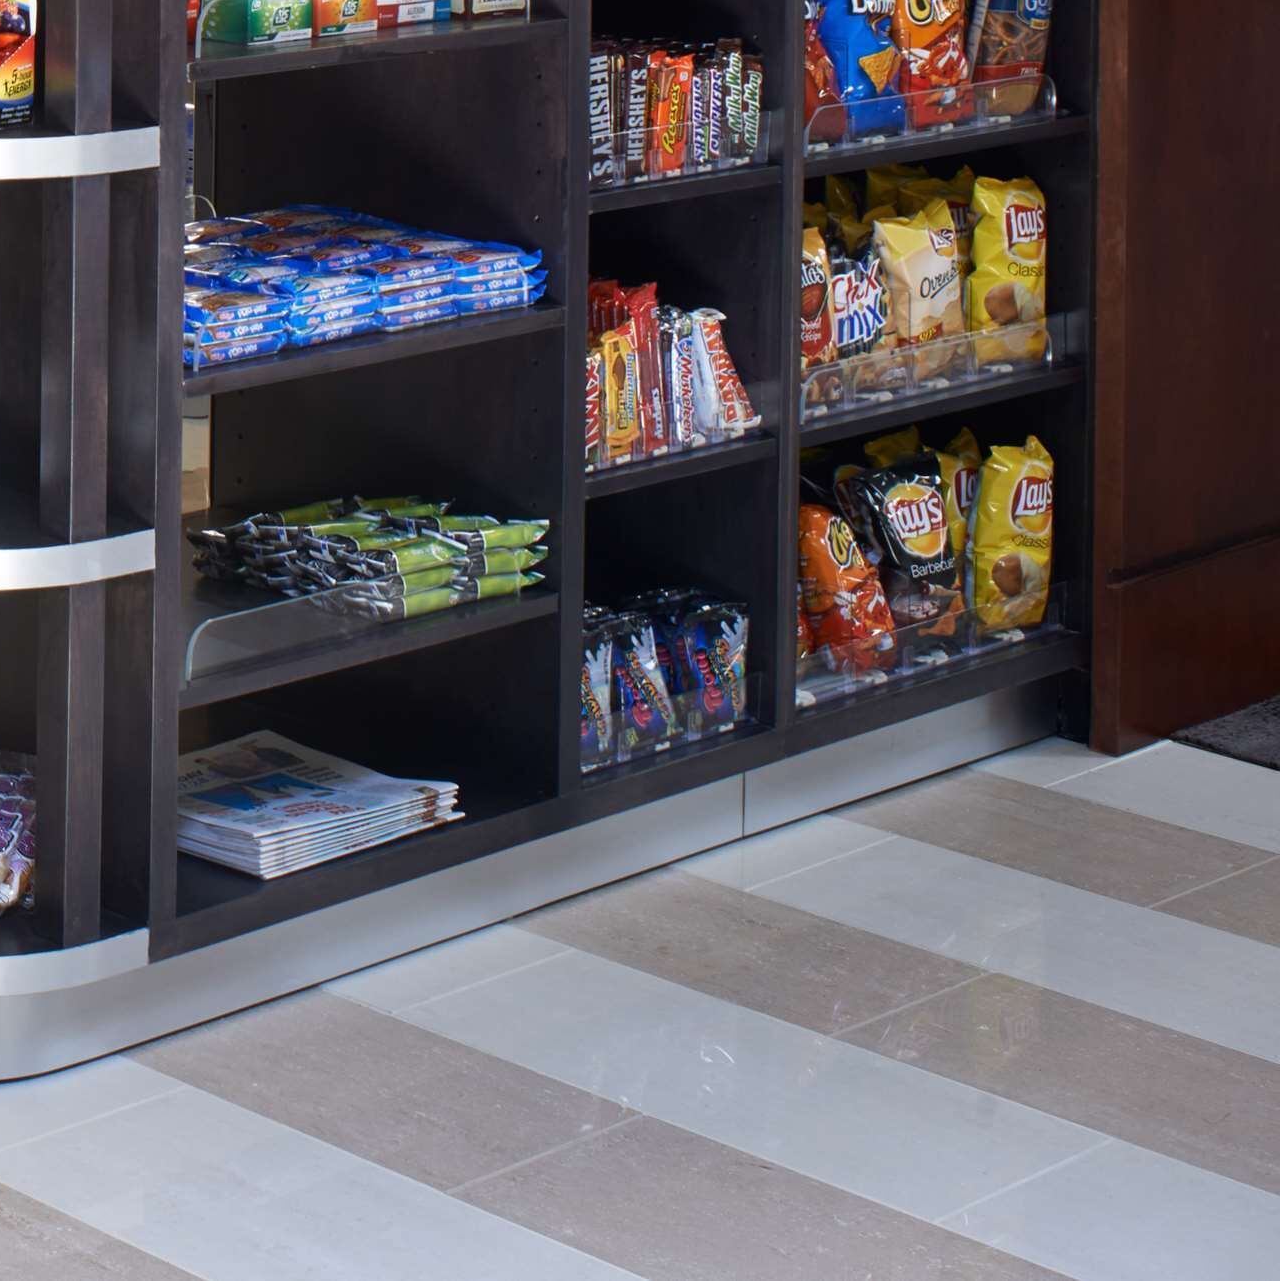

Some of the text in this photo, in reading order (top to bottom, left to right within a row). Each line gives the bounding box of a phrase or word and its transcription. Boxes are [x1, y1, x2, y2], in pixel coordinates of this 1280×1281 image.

[589, 54, 615, 177] HERSHEY'S
[627, 68, 649, 161] HERSHEY'S
[709, 68, 723, 156] SNICKERS
[1008, 205, 1046, 245] Lay's
[837, 296, 886, 346] mix
[625, 352, 635, 420] Butterfinger
[680, 356, 697, 443] Musketeers
